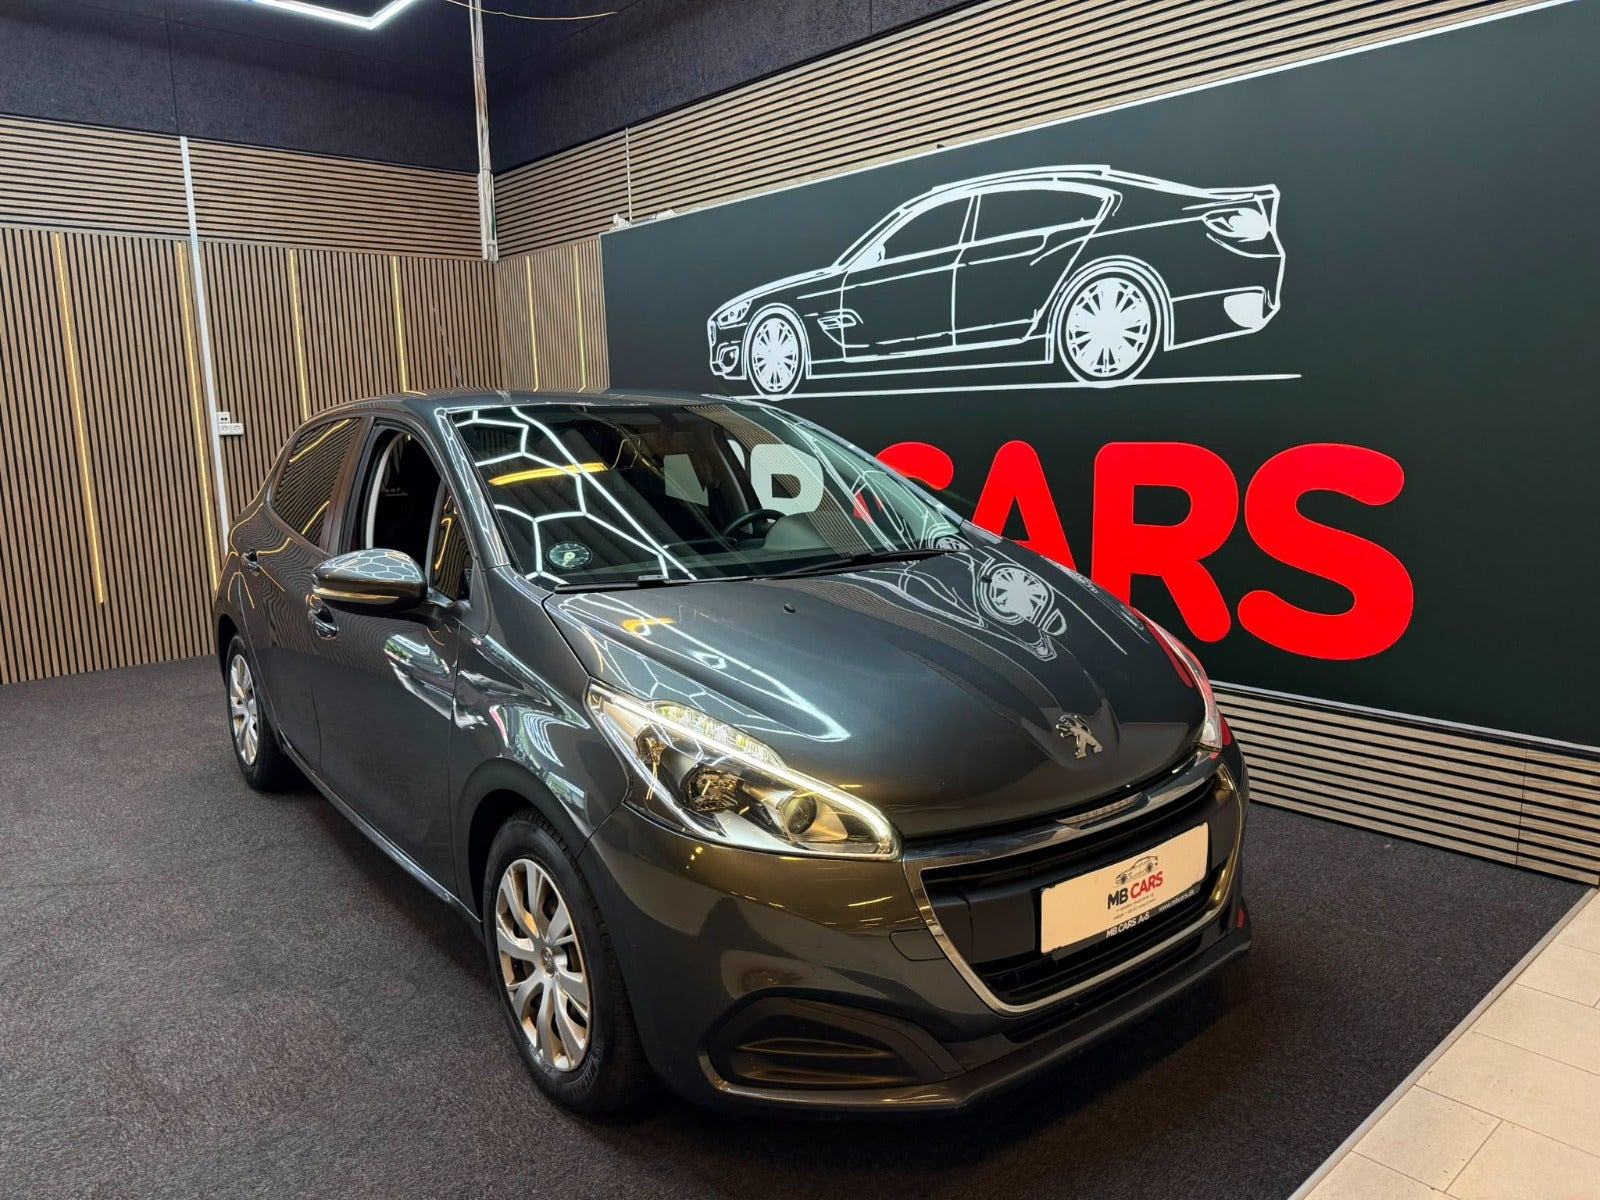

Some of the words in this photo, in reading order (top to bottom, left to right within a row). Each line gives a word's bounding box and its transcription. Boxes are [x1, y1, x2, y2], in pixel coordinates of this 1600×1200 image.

[1107, 887, 1128, 910] MB
[1130, 871, 1163, 899] CARS
[1105, 927, 1118, 939] MB
[1117, 917, 1137, 933] CARS
